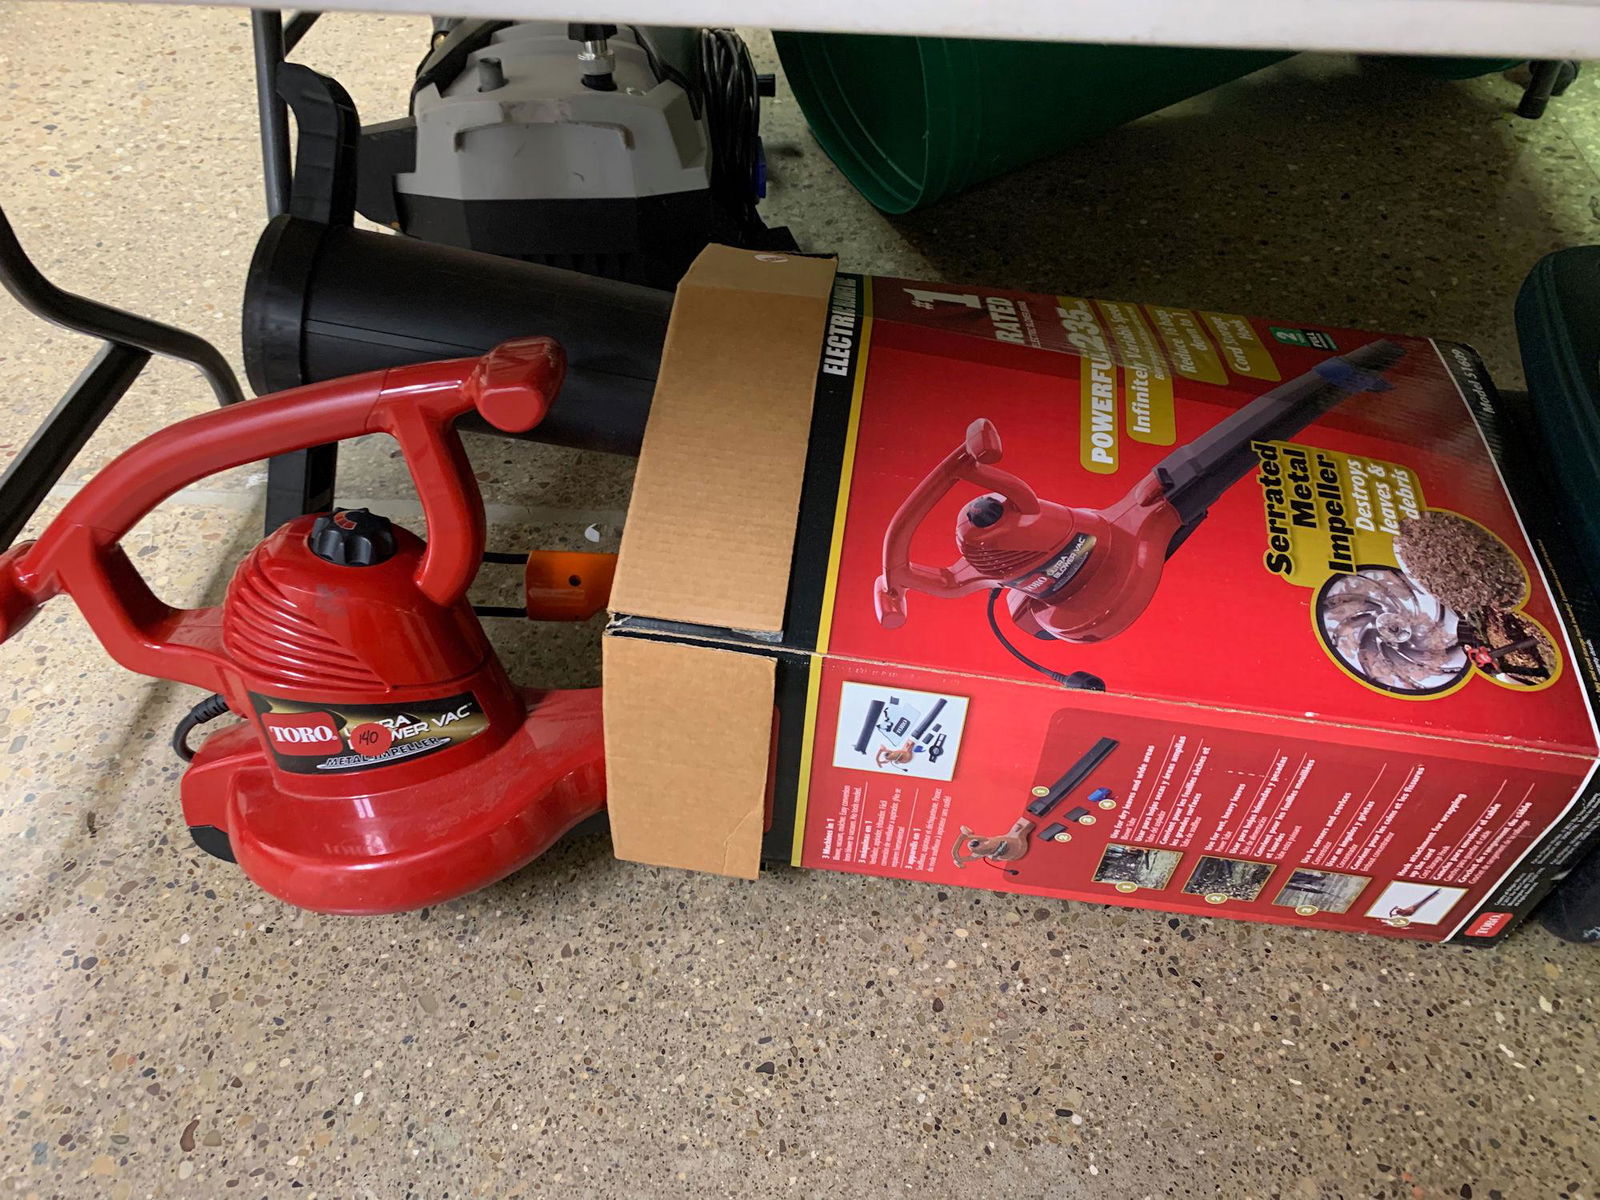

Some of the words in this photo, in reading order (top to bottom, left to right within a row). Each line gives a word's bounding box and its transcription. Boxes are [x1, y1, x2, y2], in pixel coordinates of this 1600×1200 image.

[902, 289, 982, 310] #1
[986, 296, 1025, 344] RATED
[1056, 306, 1101, 350] 235
[1190, 326, 1208, 350] down
[1276, 331, 1297, 341] 2
[1173, 337, 1198, 373] Reduce
[1226, 346, 1251, 371] Cord
[1090, 350, 1113, 464] POWERFUL
[1132, 361, 1151, 433] Infinitely
[1468, 380, 1495, 413] Model
[1368, 464, 1385, 477] &
[1283, 448, 1317, 528] Metal
[1347, 459, 1375, 532] Destroys
[1392, 469, 1420, 519] debris
[1254, 444, 1293, 575] Serrated
[1316, 454, 1354, 573] Impeller
[1374, 481, 1400, 536] leaves
[1053, 552, 1078, 579] BLOWER
[1074, 537, 1087, 552] VAC
[1023, 575, 1048, 592] TORO
[432, 704, 470, 728] VAC
[269, 726, 333, 743] TORO
[359, 730, 379, 746] 140
[327, 755, 368, 767] METAL
[1144, 746, 1154, 762] areas
[1137, 763, 1147, 778] wide
[1132, 779, 1141, 791] and
[1230, 784, 1246, 801] leaves
[1122, 792, 1136, 809] leaves
[1221, 804, 1238, 818] heavy
[1119, 811, 1130, 819] dry
[1216, 820, 1228, 831] wet,
[1110, 829, 1120, 838] Use
[1300, 855, 1312, 863] Use
[1313, 828, 1329, 847] corners
[1326, 816, 1337, 826] and
[1334, 793, 1351, 814] crevices
[822, 830, 833, 854] Machines
[1204, 841, 1215, 850] Use
[1476, 914, 1503, 935] TORO
